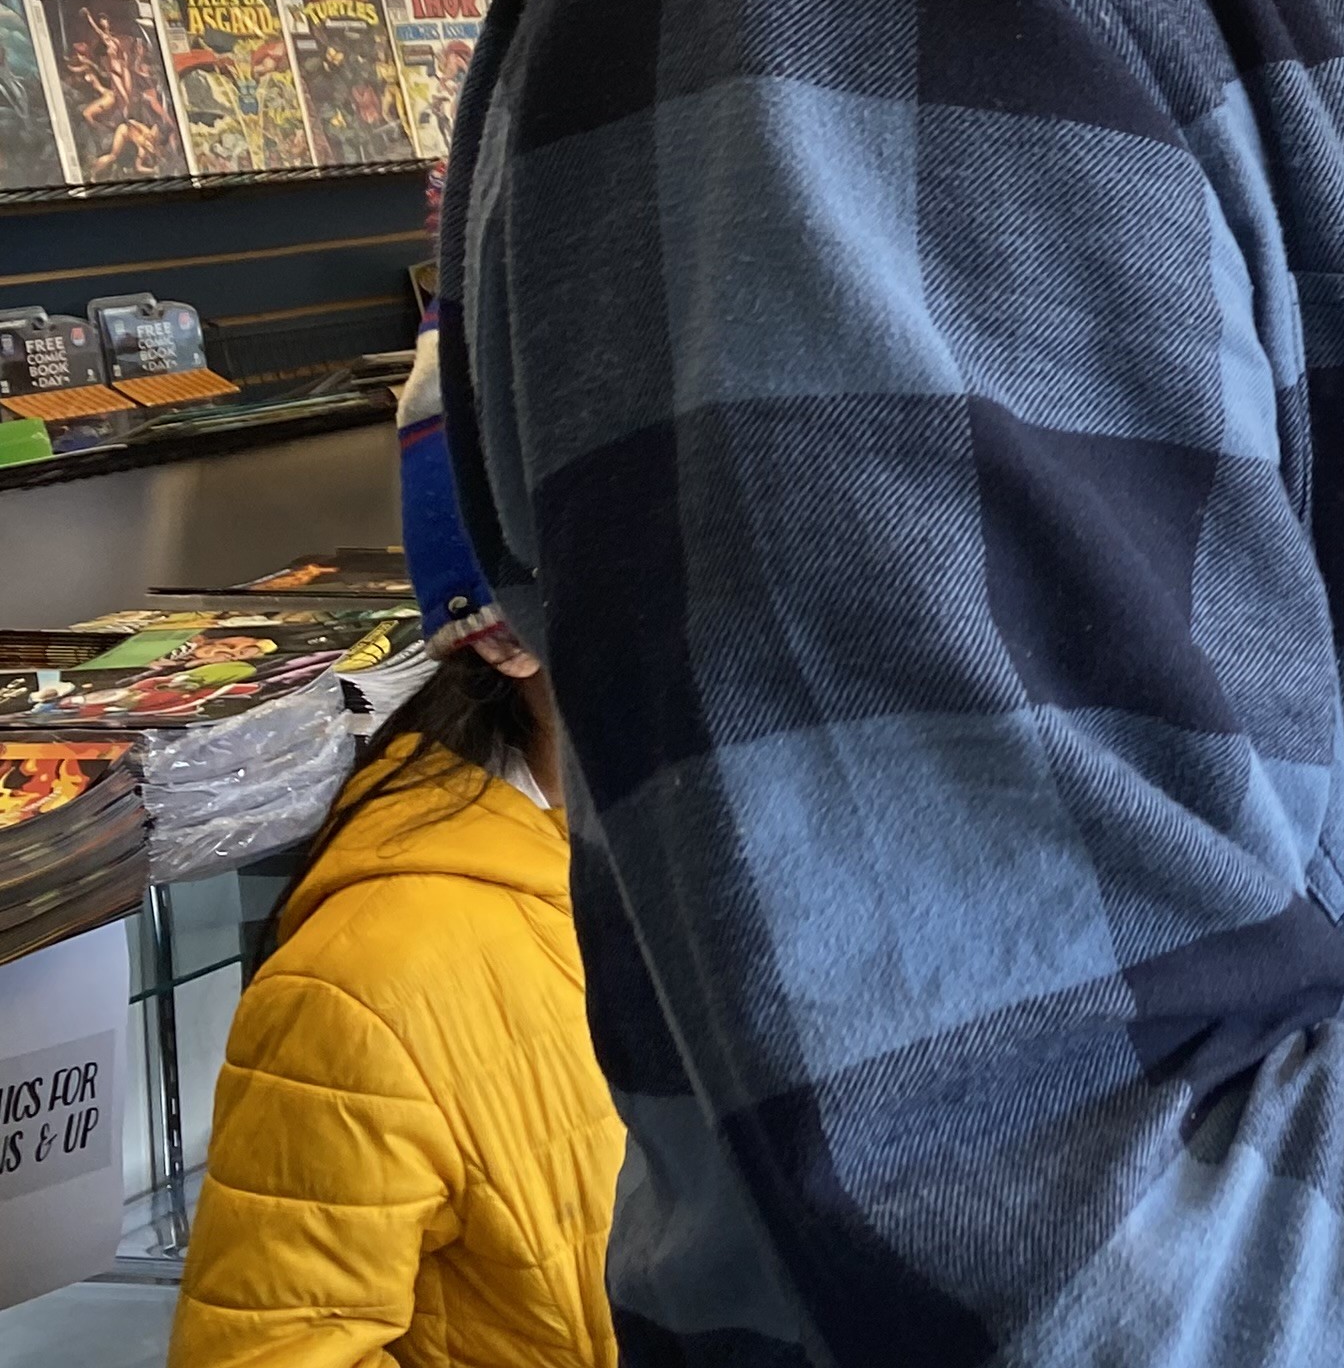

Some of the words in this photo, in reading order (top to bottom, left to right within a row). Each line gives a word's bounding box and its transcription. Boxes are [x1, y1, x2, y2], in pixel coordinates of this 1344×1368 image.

[187, 7, 274, 37] ASGARD
[137, 322, 171, 338] FREE
[25, 336, 65, 353] FREE
[138, 336, 175, 350] COMIC
[27, 351, 67, 365] COMIC
[140, 347, 177, 361] BOOK
[29, 362, 69, 378] BOOK
[38, 376, 65, 388] DAY
[0, 1077, 43, 1124] ICS
[48, 1062, 98, 1112] FOR
[35, 1123, 58, 1162] &
[64, 1107, 99, 1153] UP
